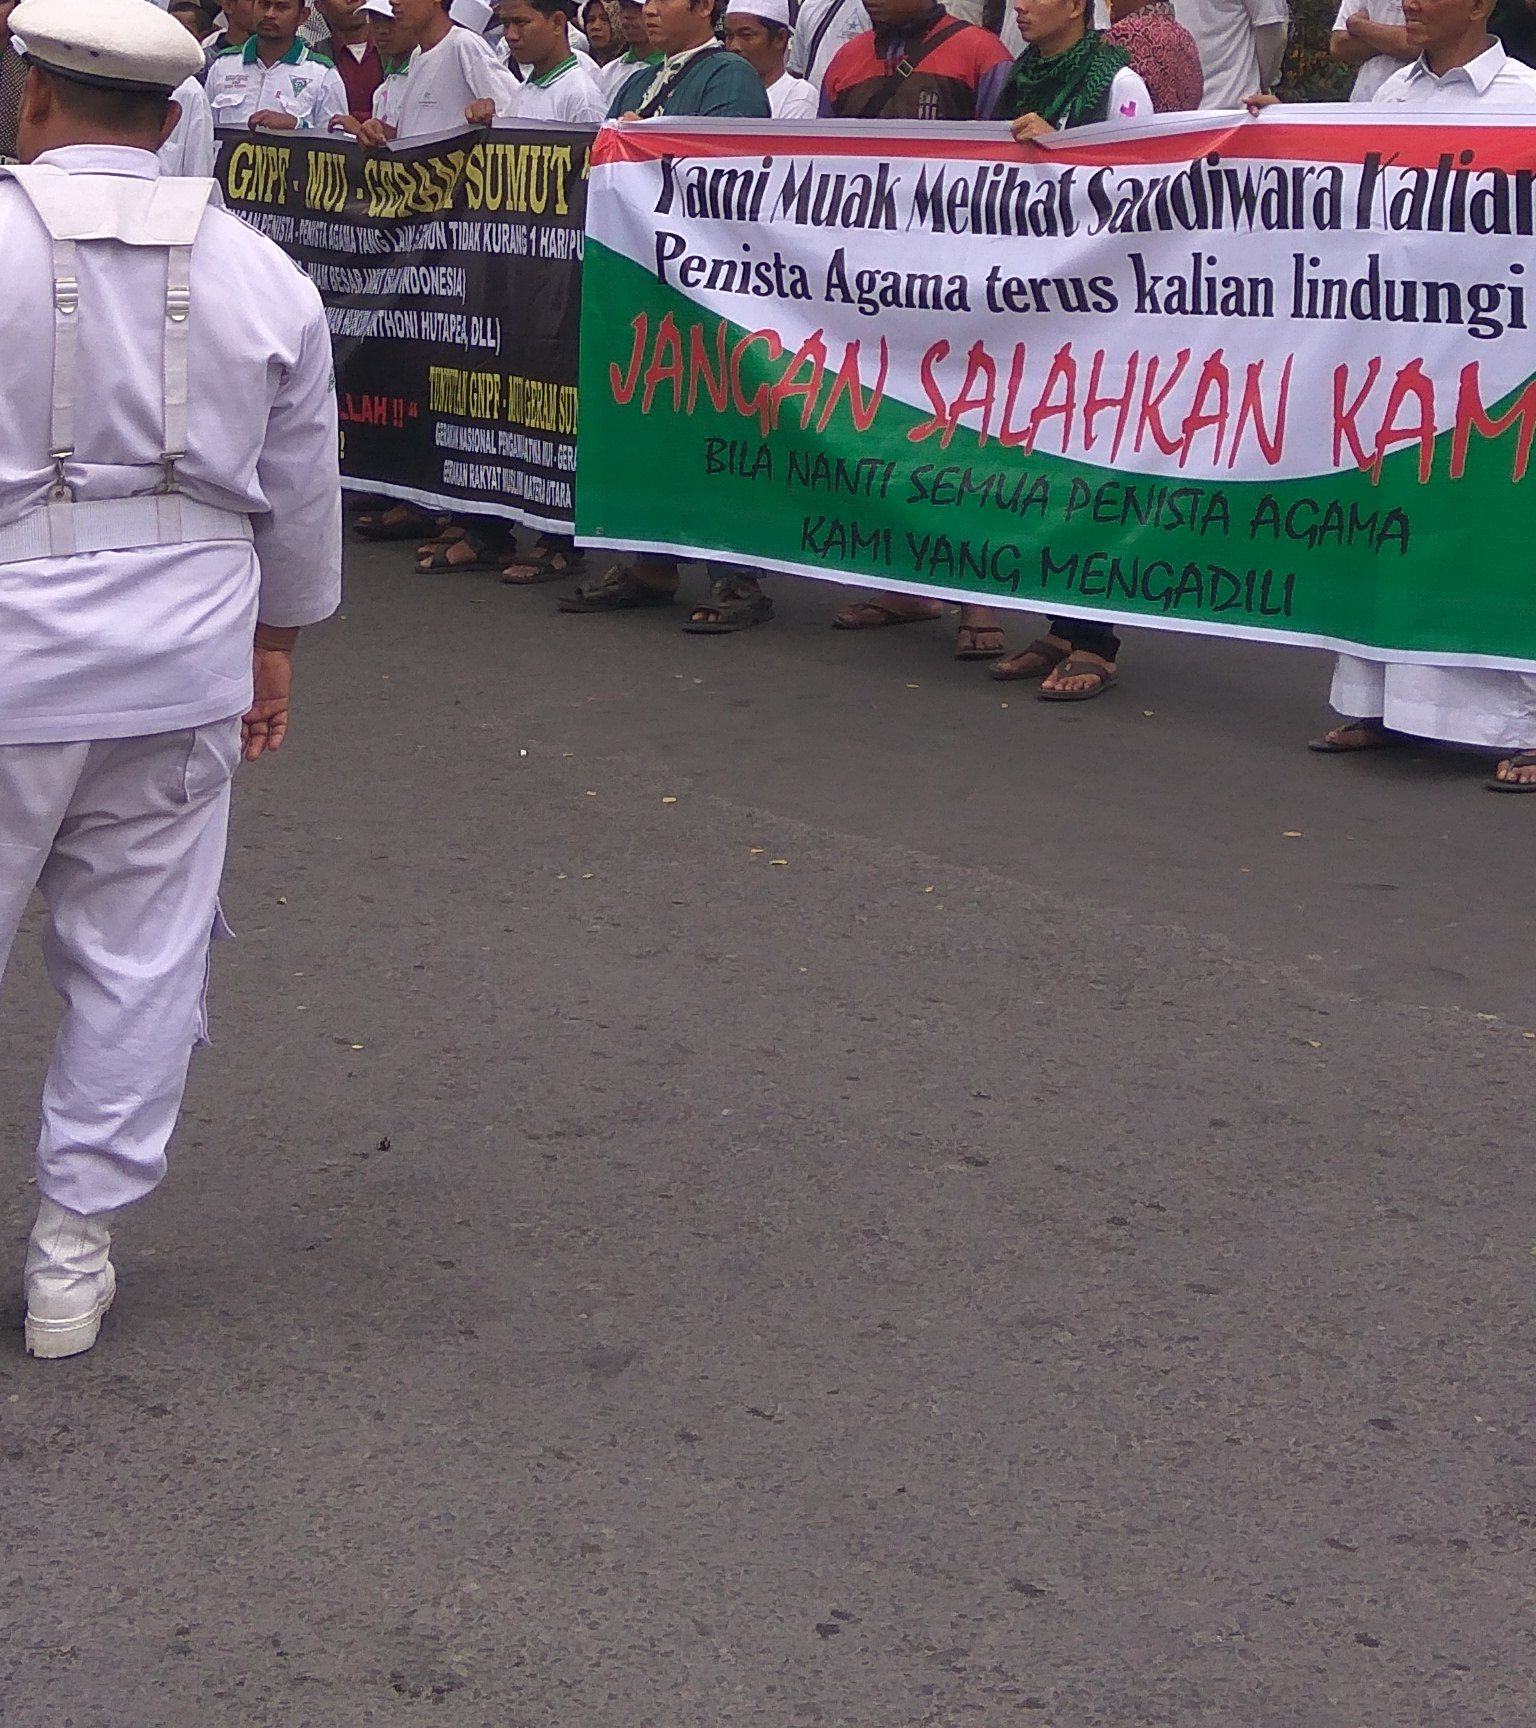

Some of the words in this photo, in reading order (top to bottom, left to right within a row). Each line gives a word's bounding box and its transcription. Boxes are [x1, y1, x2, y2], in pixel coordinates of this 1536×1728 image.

[228, 142, 291, 204] GNPF
[305, 150, 348, 213] MUI
[465, 144, 572, 215] SUMUT
[654, 153, 774, 224] Kami
[775, 159, 903, 232] Muak
[907, 161, 1084, 238] Melihat
[1087, 151, 1342, 235] Sandiwara
[449, 221, 481, 252] TIDAK
[482, 222, 528, 258] KURANG
[655, 230, 813, 302] Penista
[825, 246, 971, 316] Agama
[986, 263, 1120, 315] terus
[1128, 251, 1274, 318] kalian
[1291, 252, 1529, 339] lindungi
[470, 315, 501, 356] DLL)
[469, 371, 501, 420] GNPF
[609, 311, 890, 439] JANGAN
[907, 339, 1295, 470] SALAHKAN
[704, 436, 774, 483] BILA
[786, 448, 894, 501] NANTI
[907, 461, 1050, 520] SEMUA
[1064, 476, 1231, 537] PENISTA
[1250, 495, 1411, 556] AGAMA
[800, 515, 893, 566] KAMI
[907, 529, 1021, 593] YANG
[1040, 551, 1296, 618] MENGADILI
